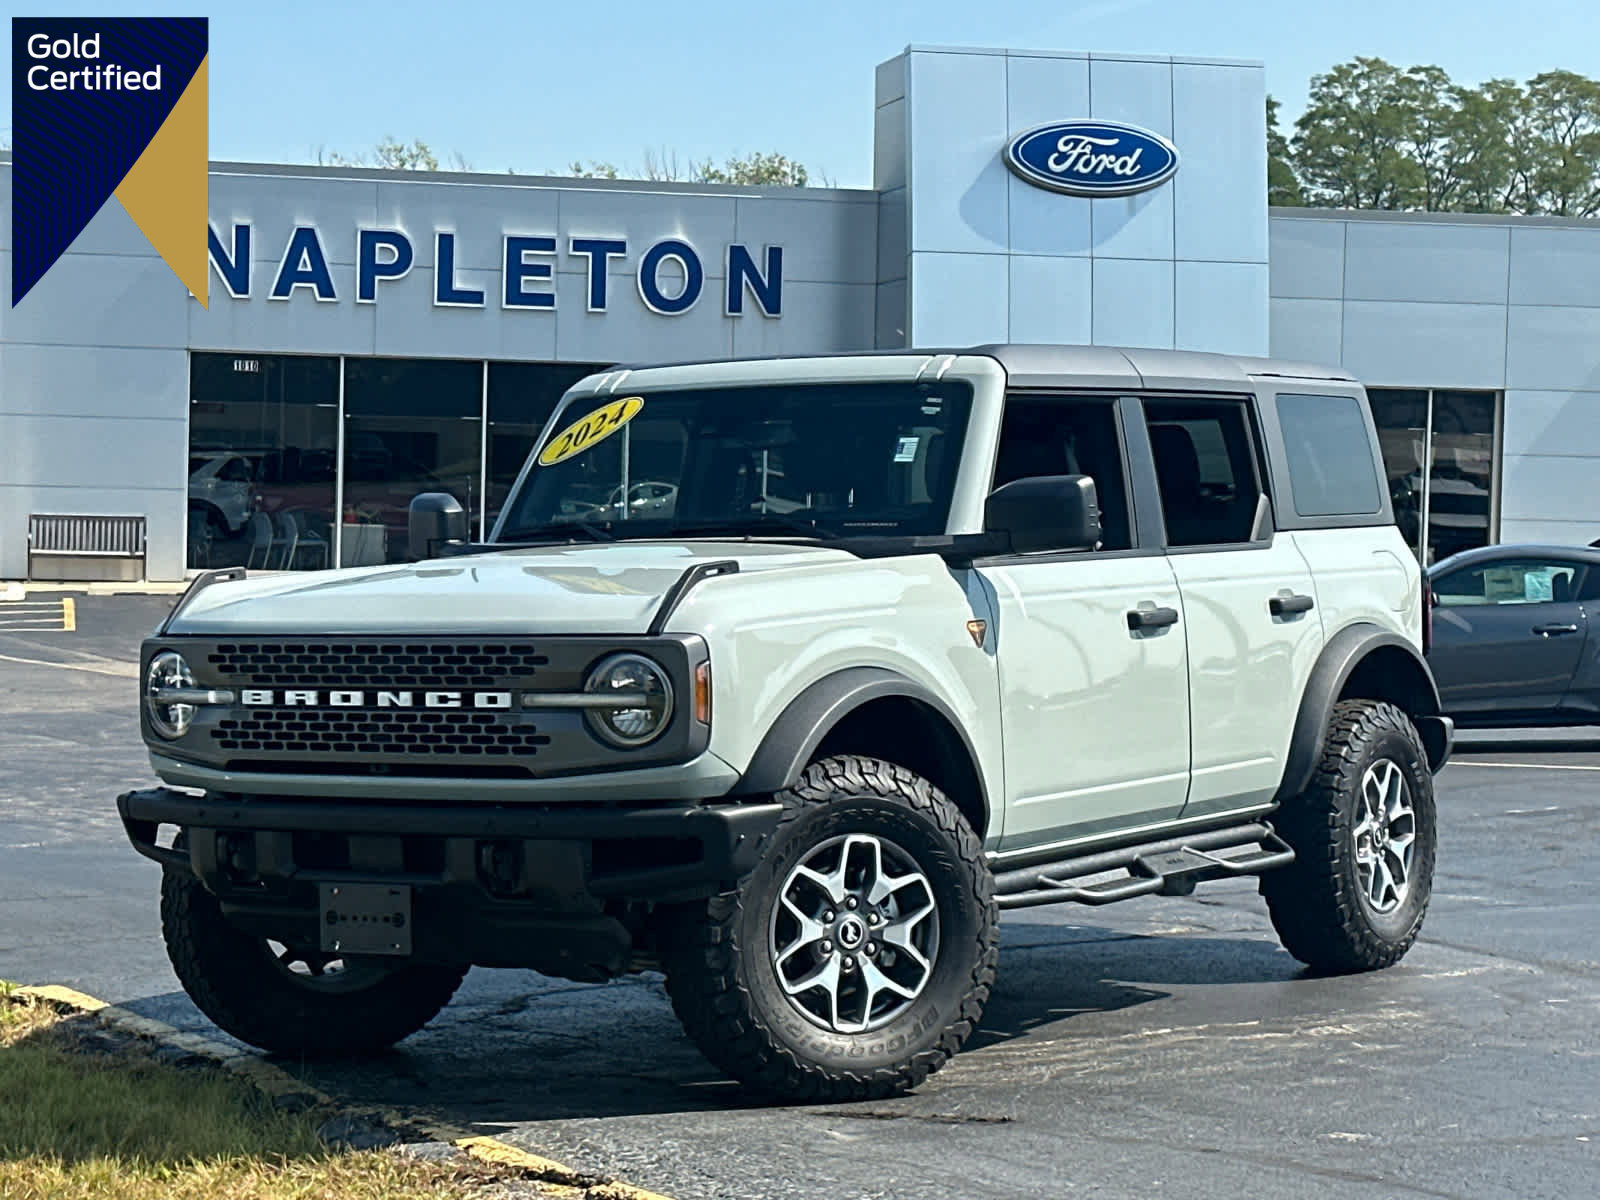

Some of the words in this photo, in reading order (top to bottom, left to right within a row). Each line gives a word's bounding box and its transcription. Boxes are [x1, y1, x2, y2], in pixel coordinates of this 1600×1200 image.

[1047, 134, 1143, 176] Ford
[206, 220, 783, 318] NAPLETON
[555, 400, 629, 459] 2024
[241, 689, 512, 709] BRONCO
